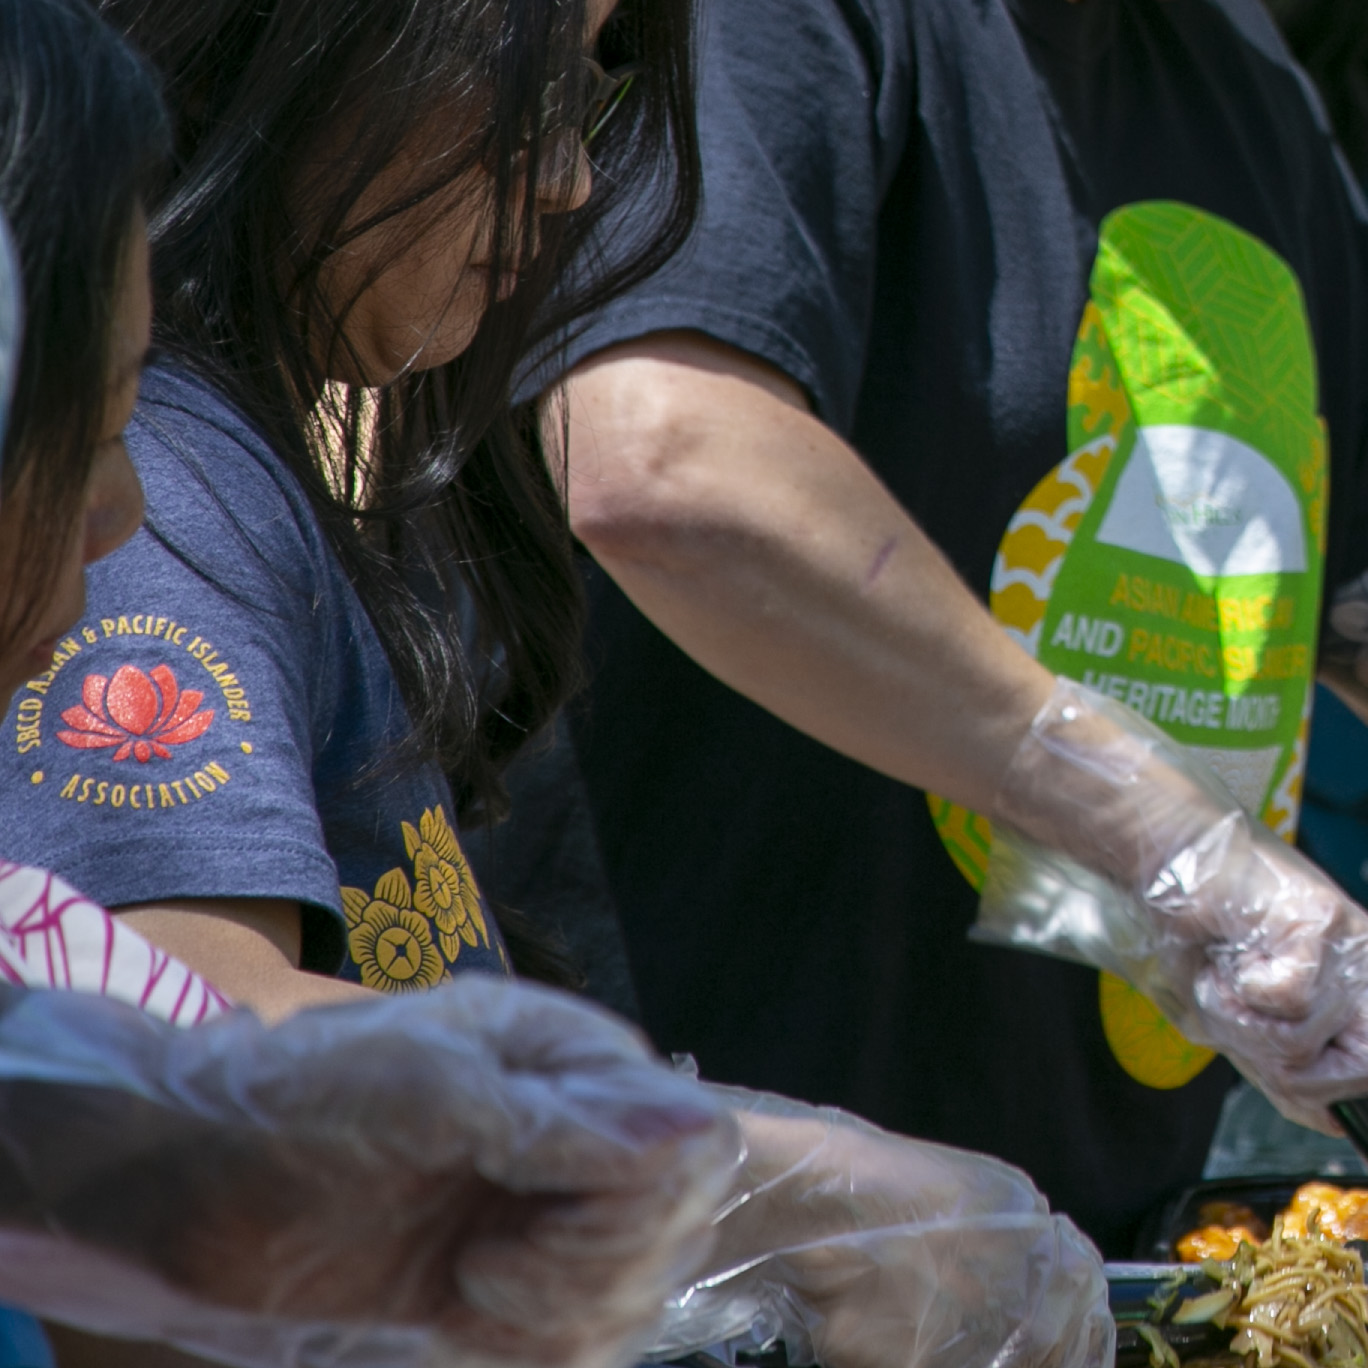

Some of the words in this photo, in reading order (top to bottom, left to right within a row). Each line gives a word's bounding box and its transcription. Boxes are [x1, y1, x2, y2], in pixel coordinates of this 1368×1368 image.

[1108, 573, 1180, 620] ASIAN
[1051, 612, 1125, 658] AND
[16, 698, 43, 754] SBCCD
[82, 626, 98, 644] &
[101, 615, 188, 646] PACIFIC
[186, 636, 252, 722] ISLANDER
[1226, 694, 1281, 731] MONT
[60, 761, 231, 809] ASSOCIATION
